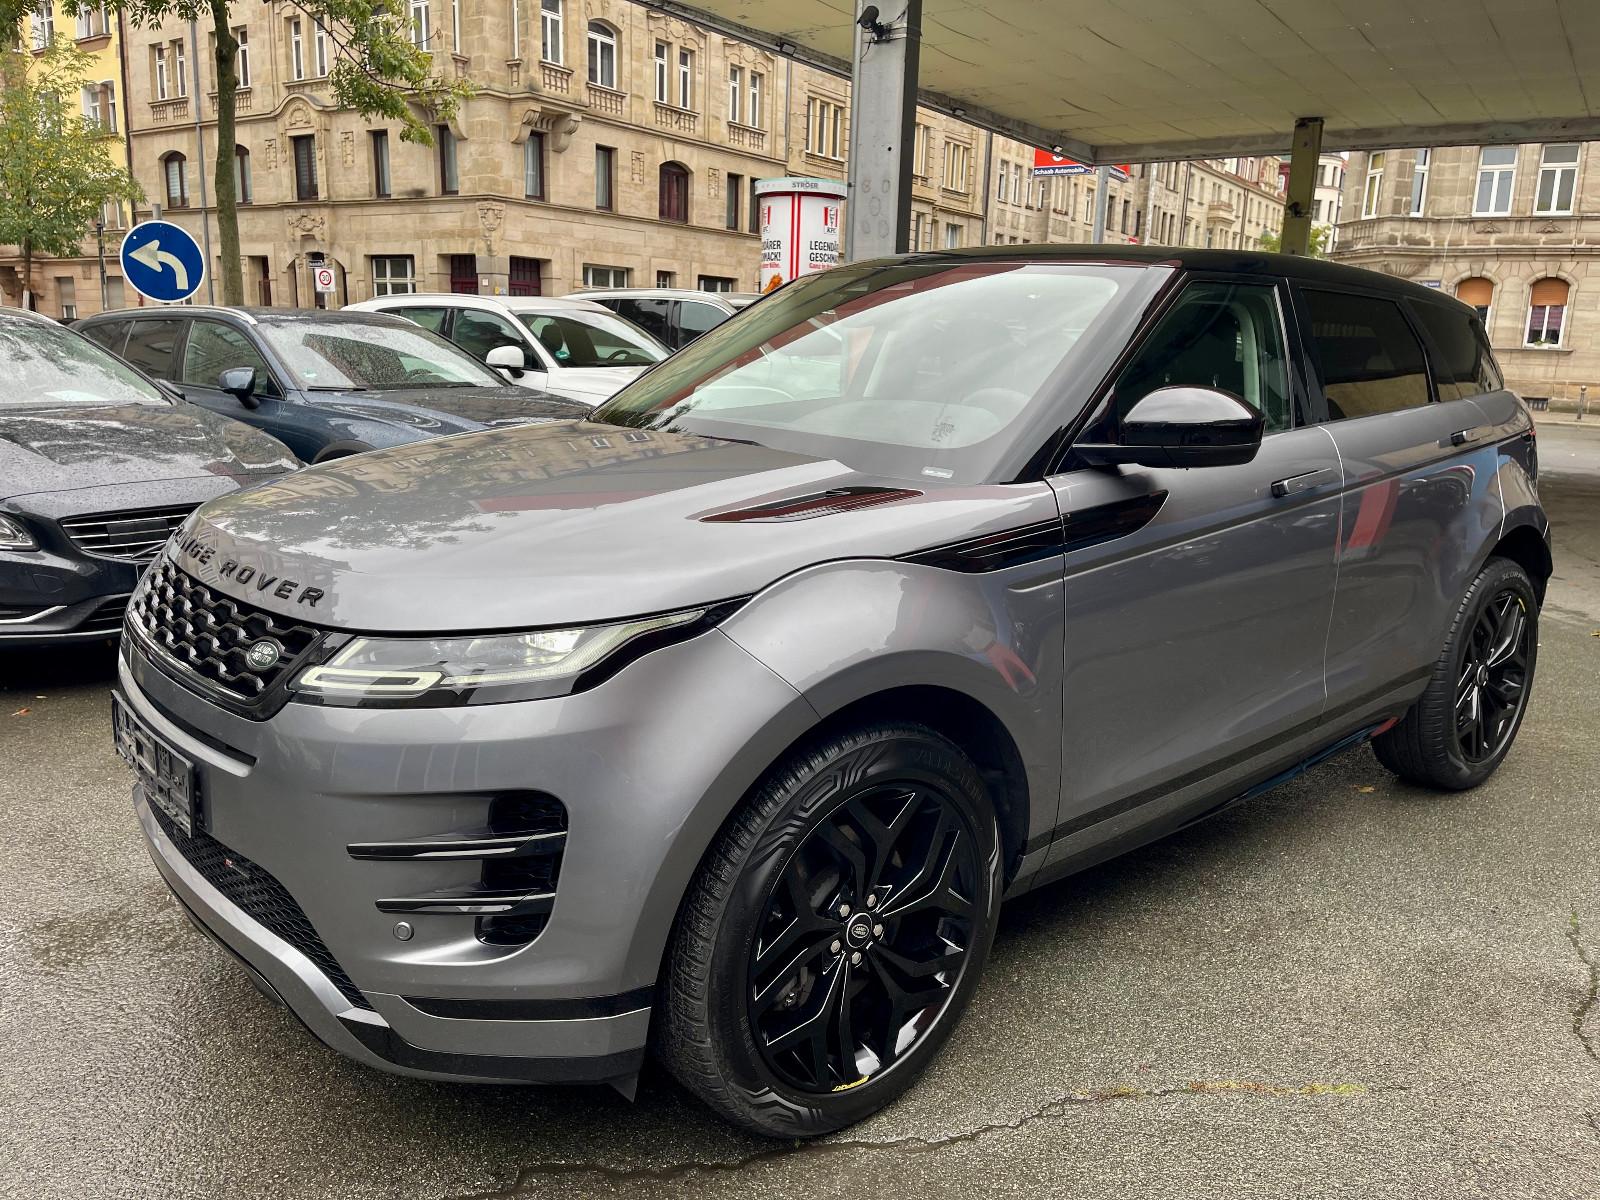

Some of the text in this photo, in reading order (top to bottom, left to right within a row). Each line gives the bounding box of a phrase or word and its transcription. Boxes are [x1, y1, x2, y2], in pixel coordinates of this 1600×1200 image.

[791, 181, 818, 189] STRÖER
[322, 274, 330, 282] 30
[219, 559, 325, 608] ROVER
[251, 651, 272, 664] ROVER
